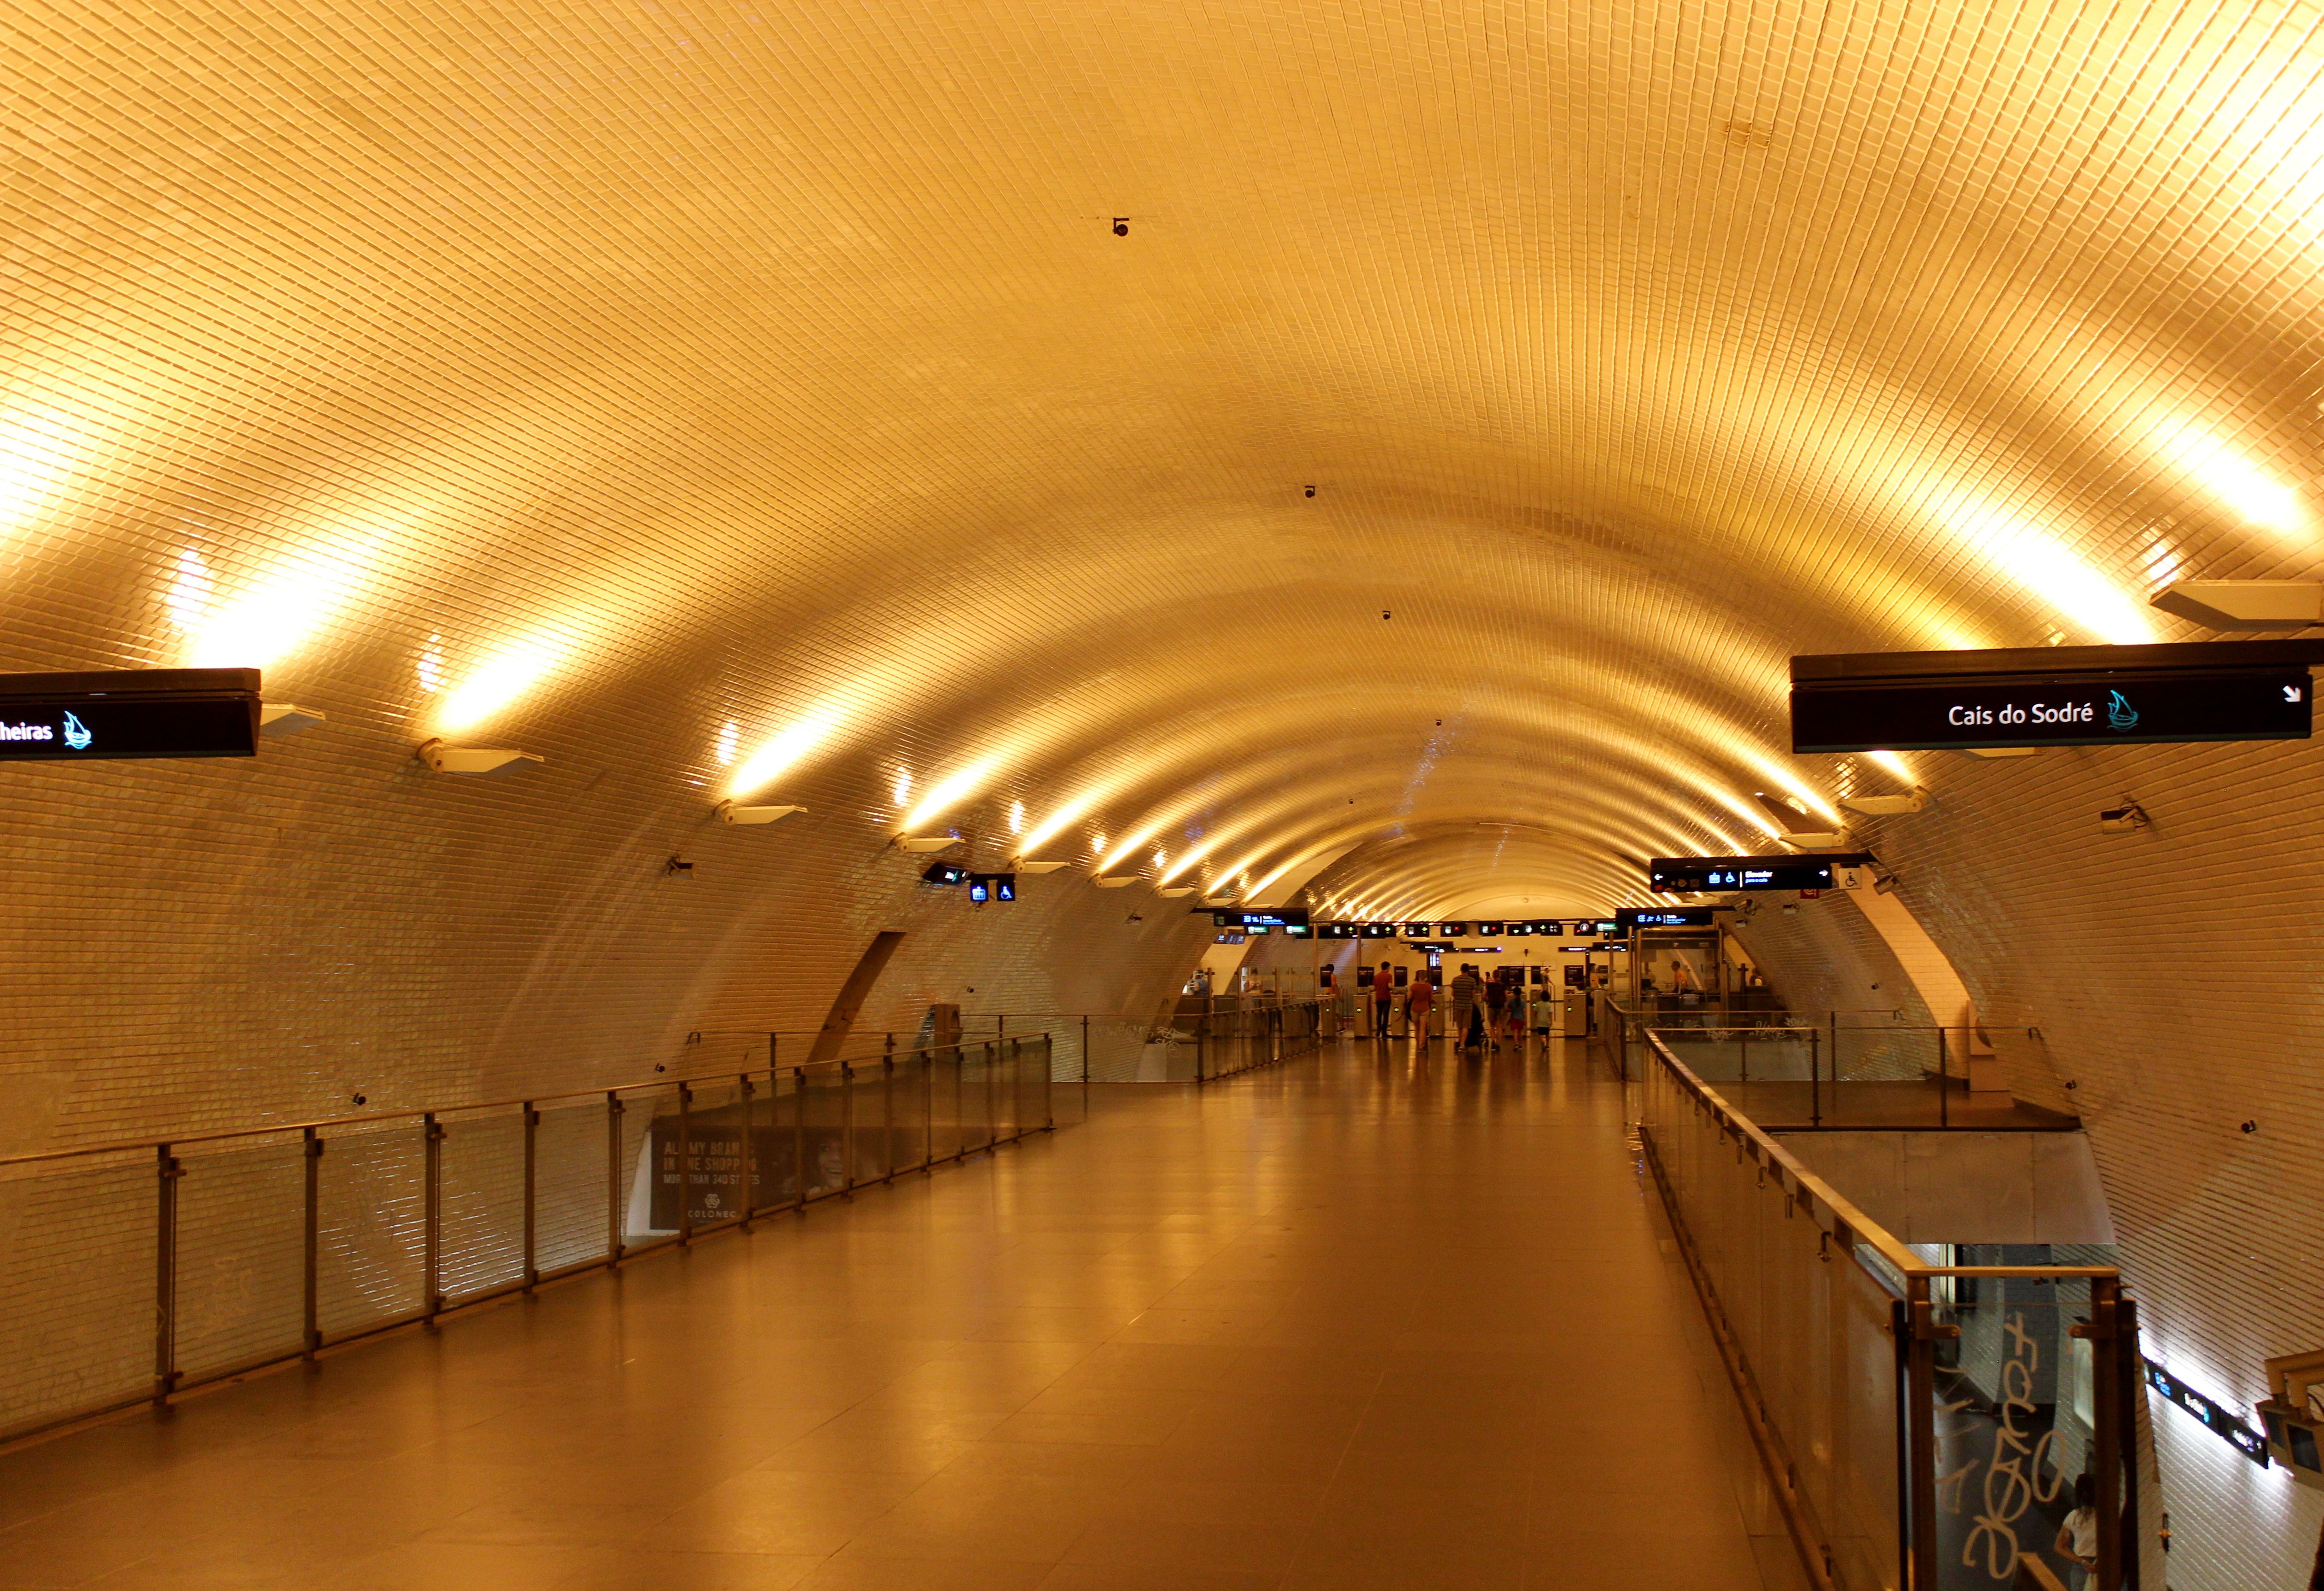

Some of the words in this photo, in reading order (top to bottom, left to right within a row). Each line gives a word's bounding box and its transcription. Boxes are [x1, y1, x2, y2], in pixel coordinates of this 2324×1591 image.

[1948, 705, 1993, 726] Cais
[1998, 703, 2026, 724] do
[2031, 702, 2094, 724] Sodré
[0, 721, 53, 741] heiras
[689, 1142, 706, 1155] MY
[710, 1142, 755, 1156] BRAN
[663, 1157, 675, 1171] IN
[705, 1157, 761, 1172] SHOPPG.
[663, 1174, 681, 1184] MOR
[688, 1174, 709, 1184] THAN
[712, 1174, 728, 1184] 340
[729, 1175, 761, 1185] STES
